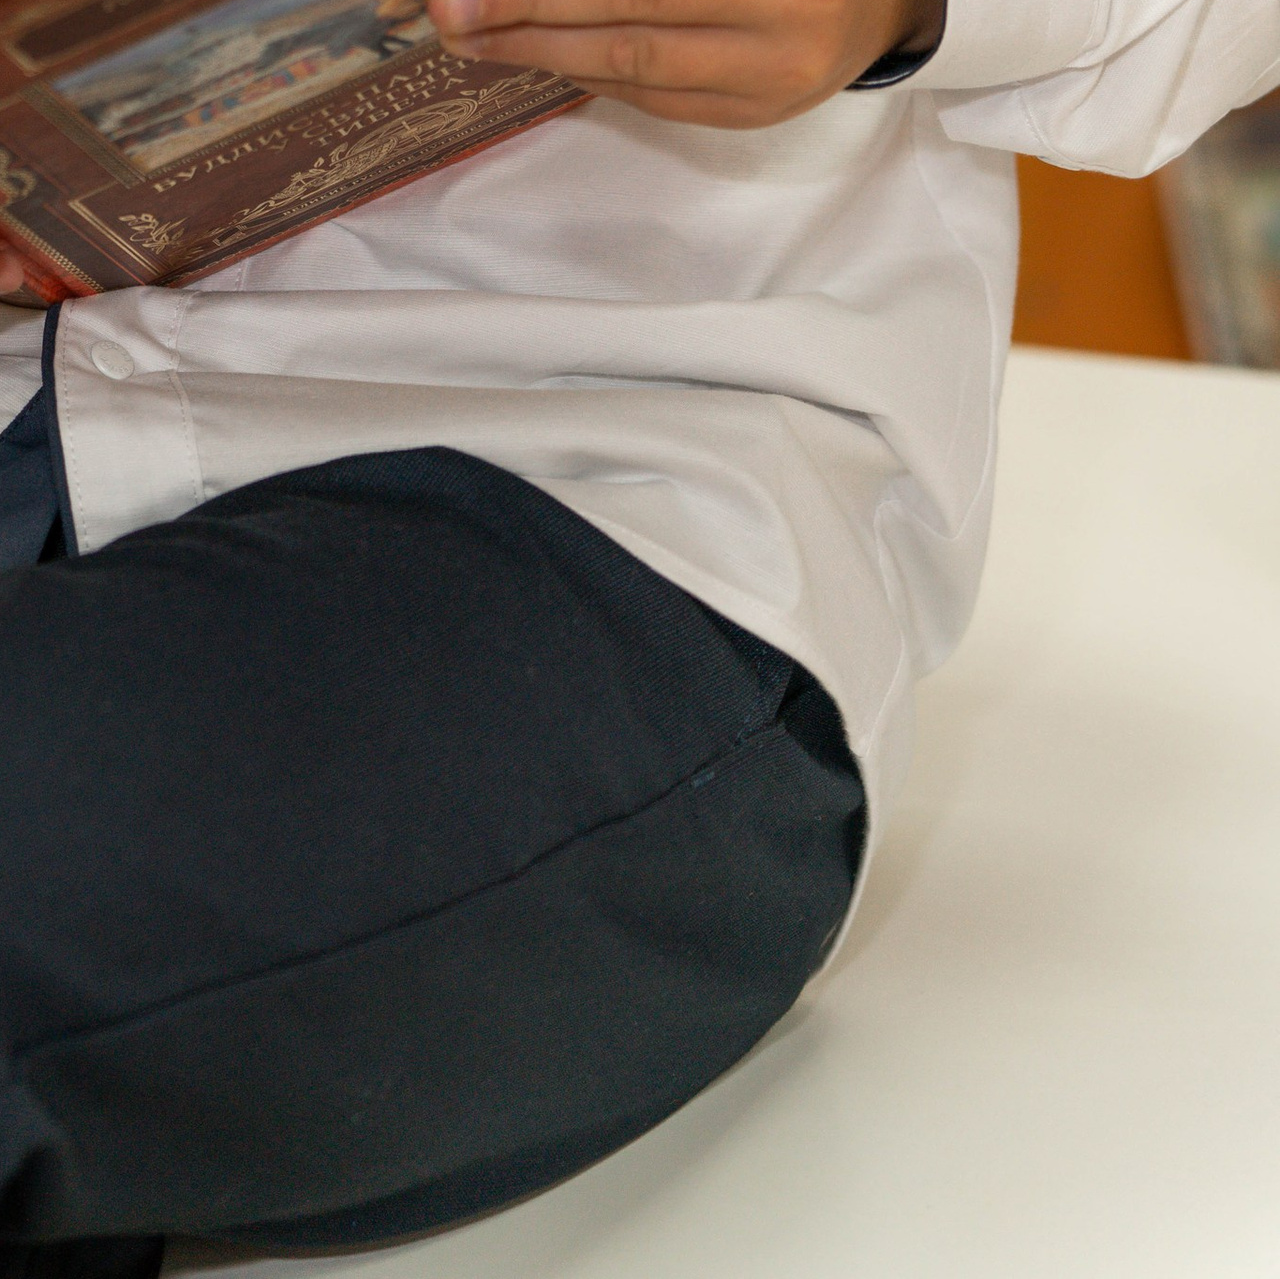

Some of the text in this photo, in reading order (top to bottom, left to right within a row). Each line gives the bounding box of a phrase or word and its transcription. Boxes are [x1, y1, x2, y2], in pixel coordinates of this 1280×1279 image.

[267, 58, 481, 154] У СВЯТЫН
[309, 77, 468, 147] ТИБЕТА
[283, 186, 344, 216] ВЕЛИКИЕ
